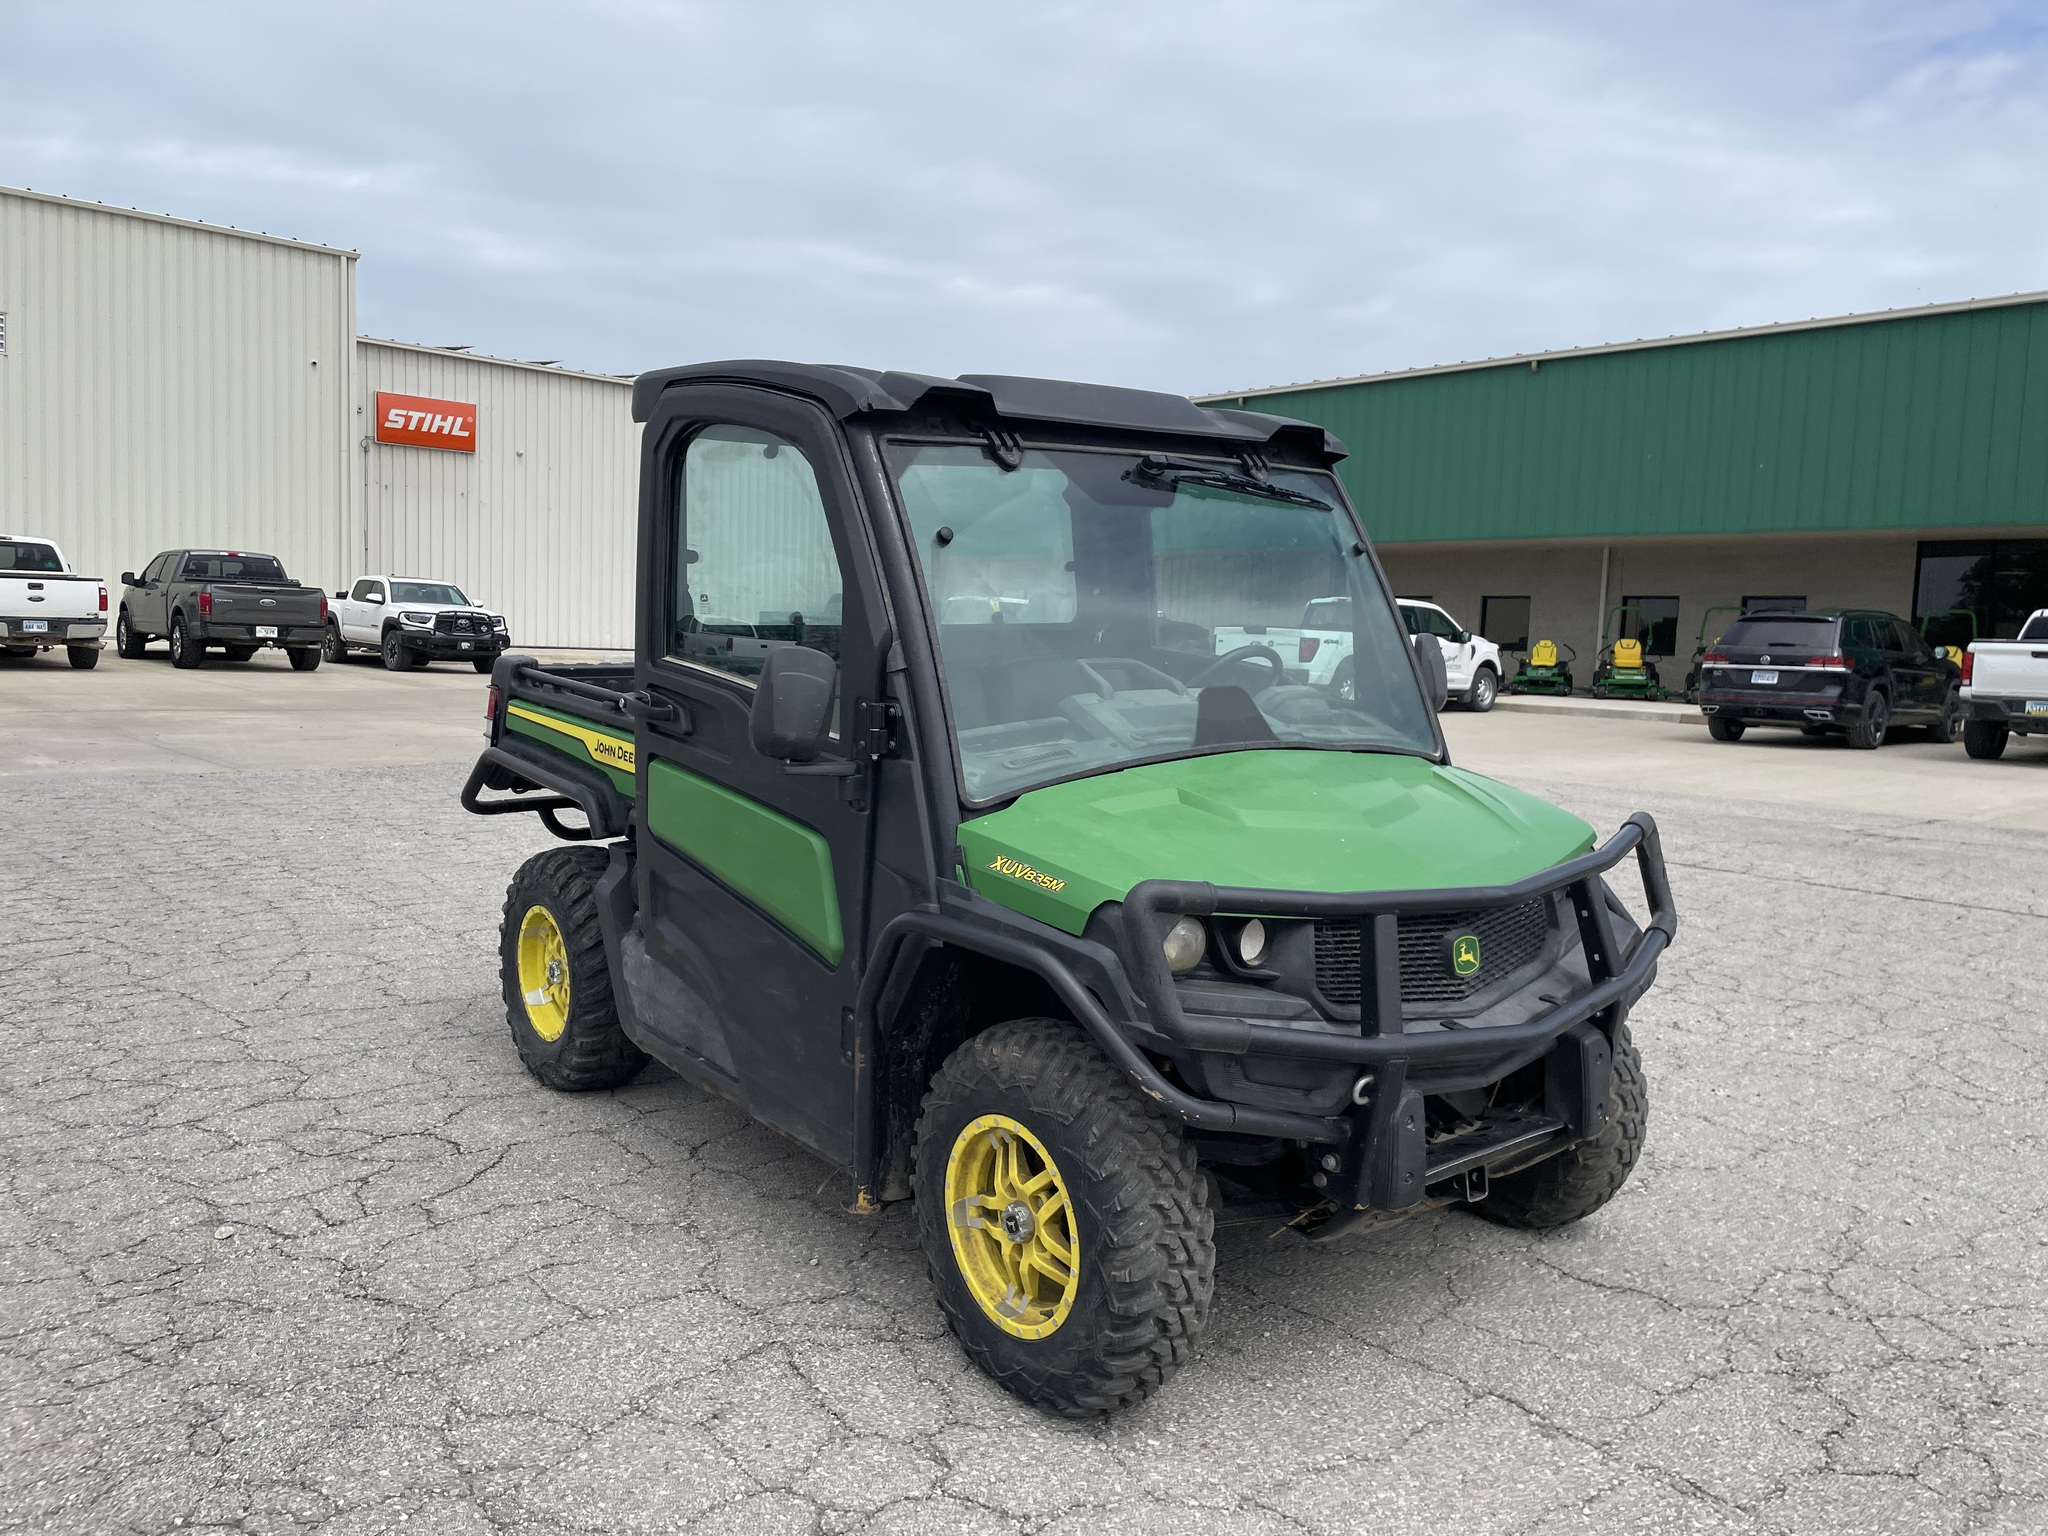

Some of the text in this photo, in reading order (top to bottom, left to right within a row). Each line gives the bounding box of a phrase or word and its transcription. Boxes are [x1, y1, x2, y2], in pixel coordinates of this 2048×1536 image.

[384, 408, 470, 437] STIHL
[594, 739, 635, 765] JOHN DEE
[989, 855, 1066, 892] XUV835M
